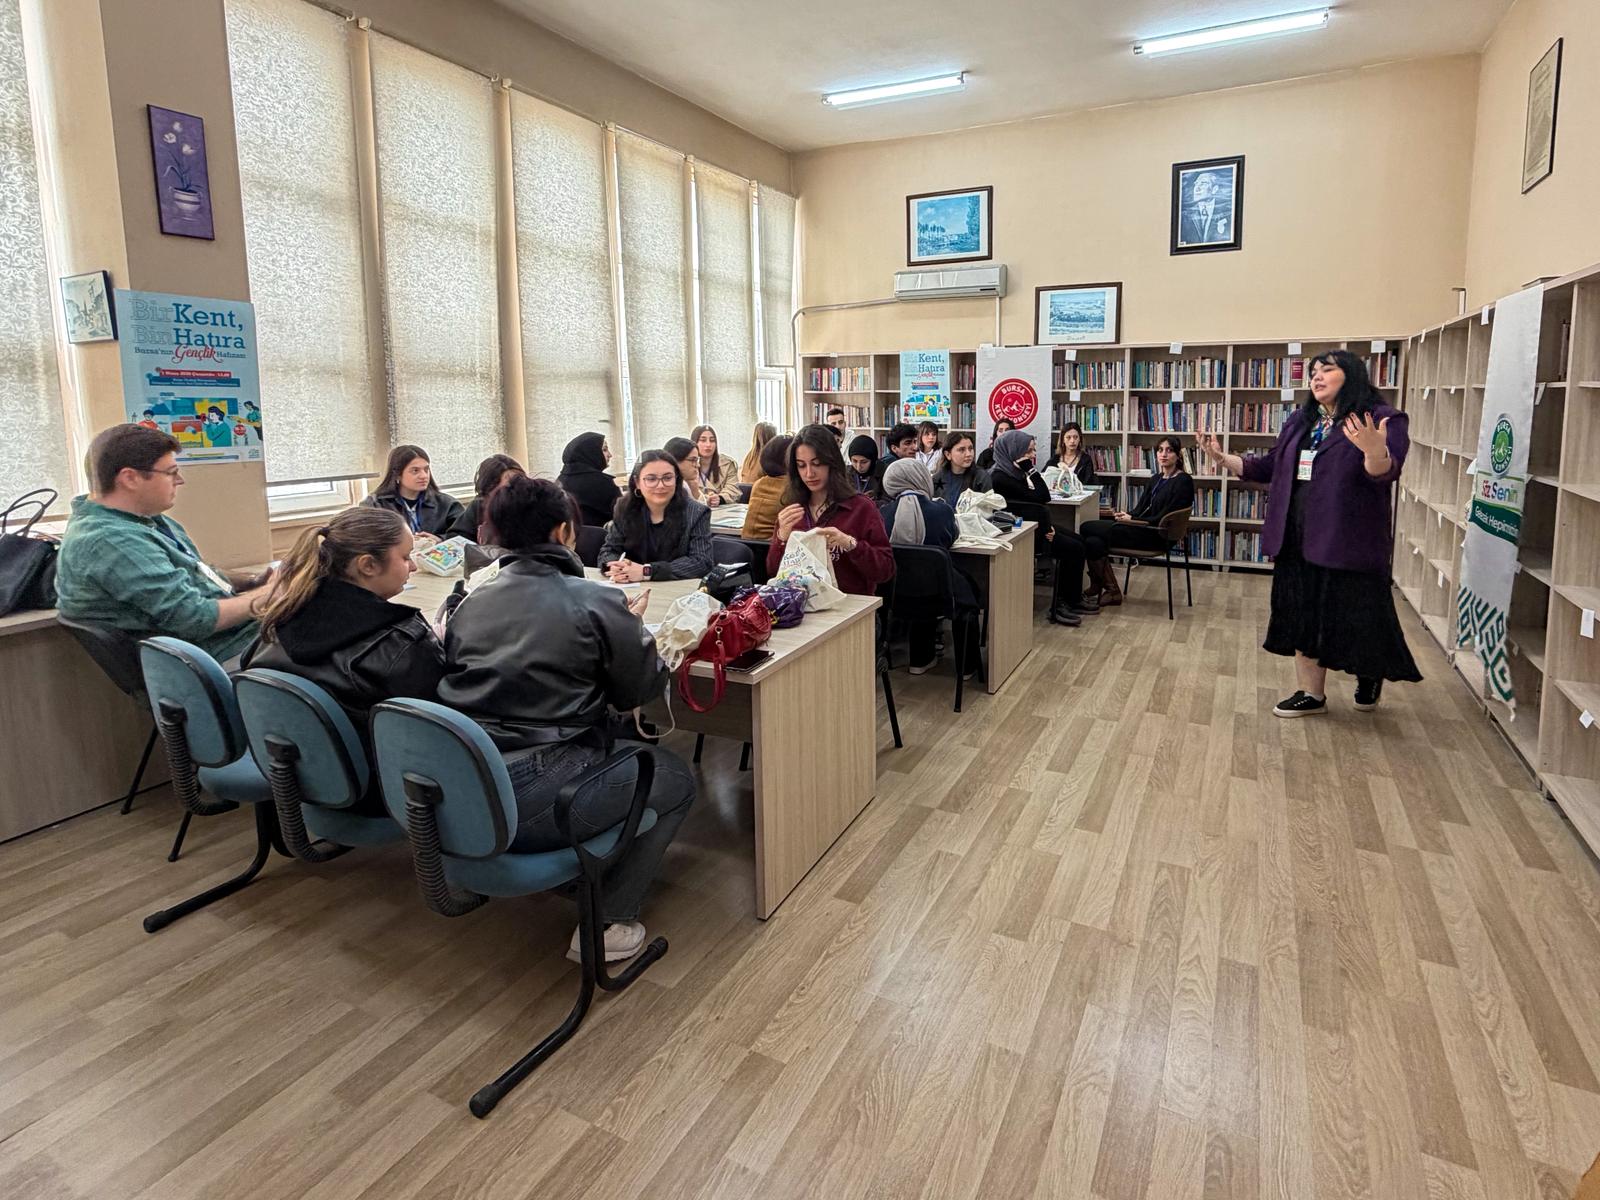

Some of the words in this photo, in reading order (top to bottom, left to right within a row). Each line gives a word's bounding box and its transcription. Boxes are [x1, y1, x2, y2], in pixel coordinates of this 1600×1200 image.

[128, 298, 173, 322] Bir
[172, 303, 244, 331] Kent,
[131, 324, 174, 345] Bin
[173, 328, 246, 349] Hatıra
[171, 343, 224, 364] Gençlik
[918, 353, 945, 364] Kent,
[1001, 385, 1025, 395] BURSA
